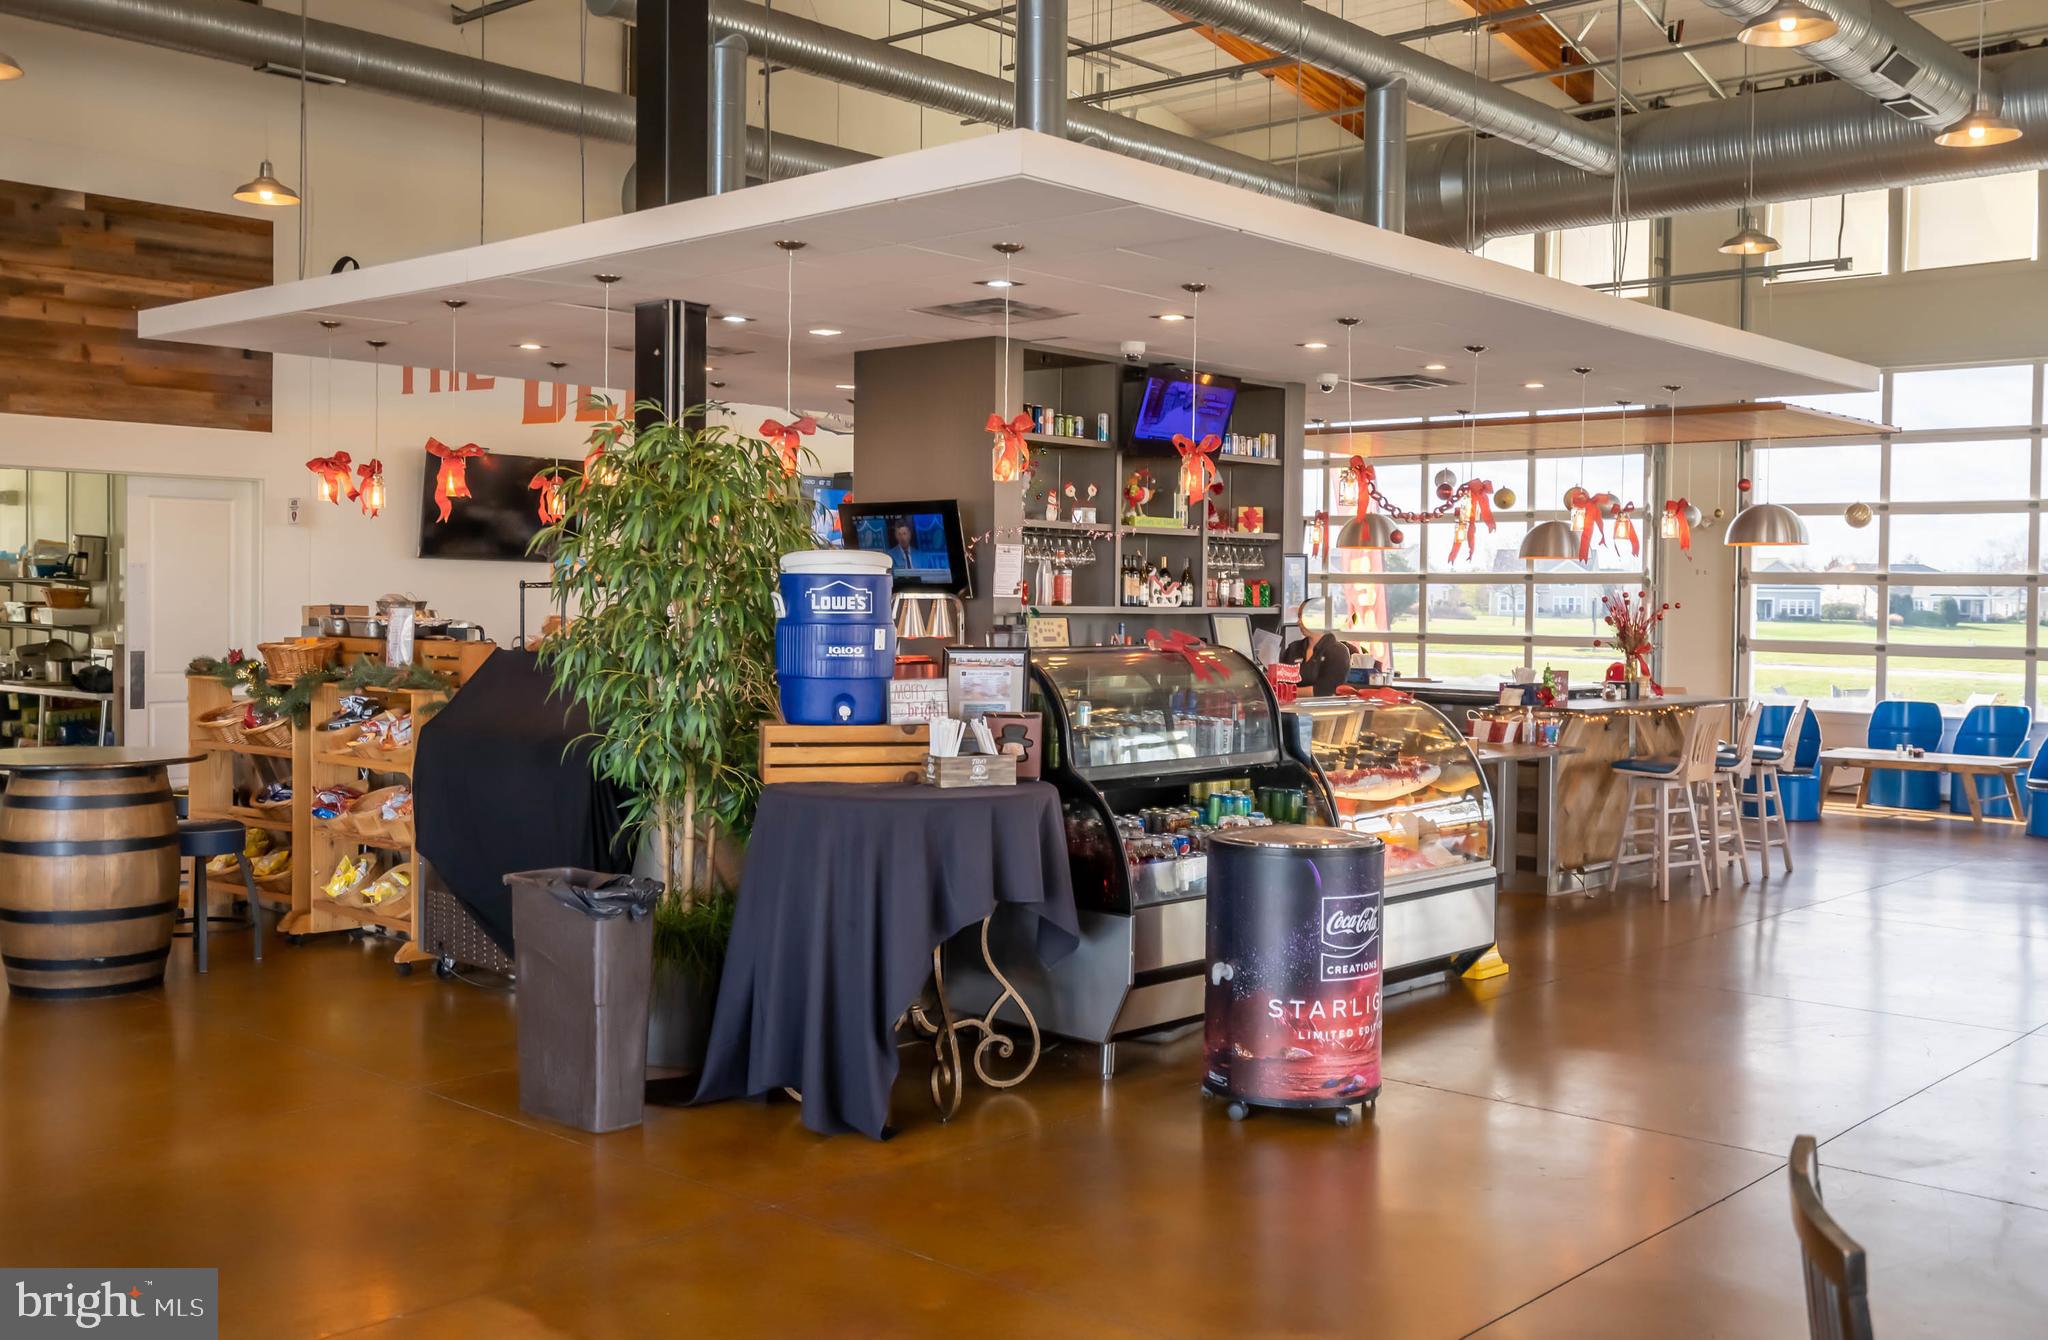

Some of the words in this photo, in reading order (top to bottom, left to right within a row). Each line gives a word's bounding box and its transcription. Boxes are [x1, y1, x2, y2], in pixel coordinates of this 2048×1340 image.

[811, 593, 866, 610] LOWE'S
[1327, 960, 1377, 975] CREATIONS
[1298, 1028, 1353, 1040] LIMITED
